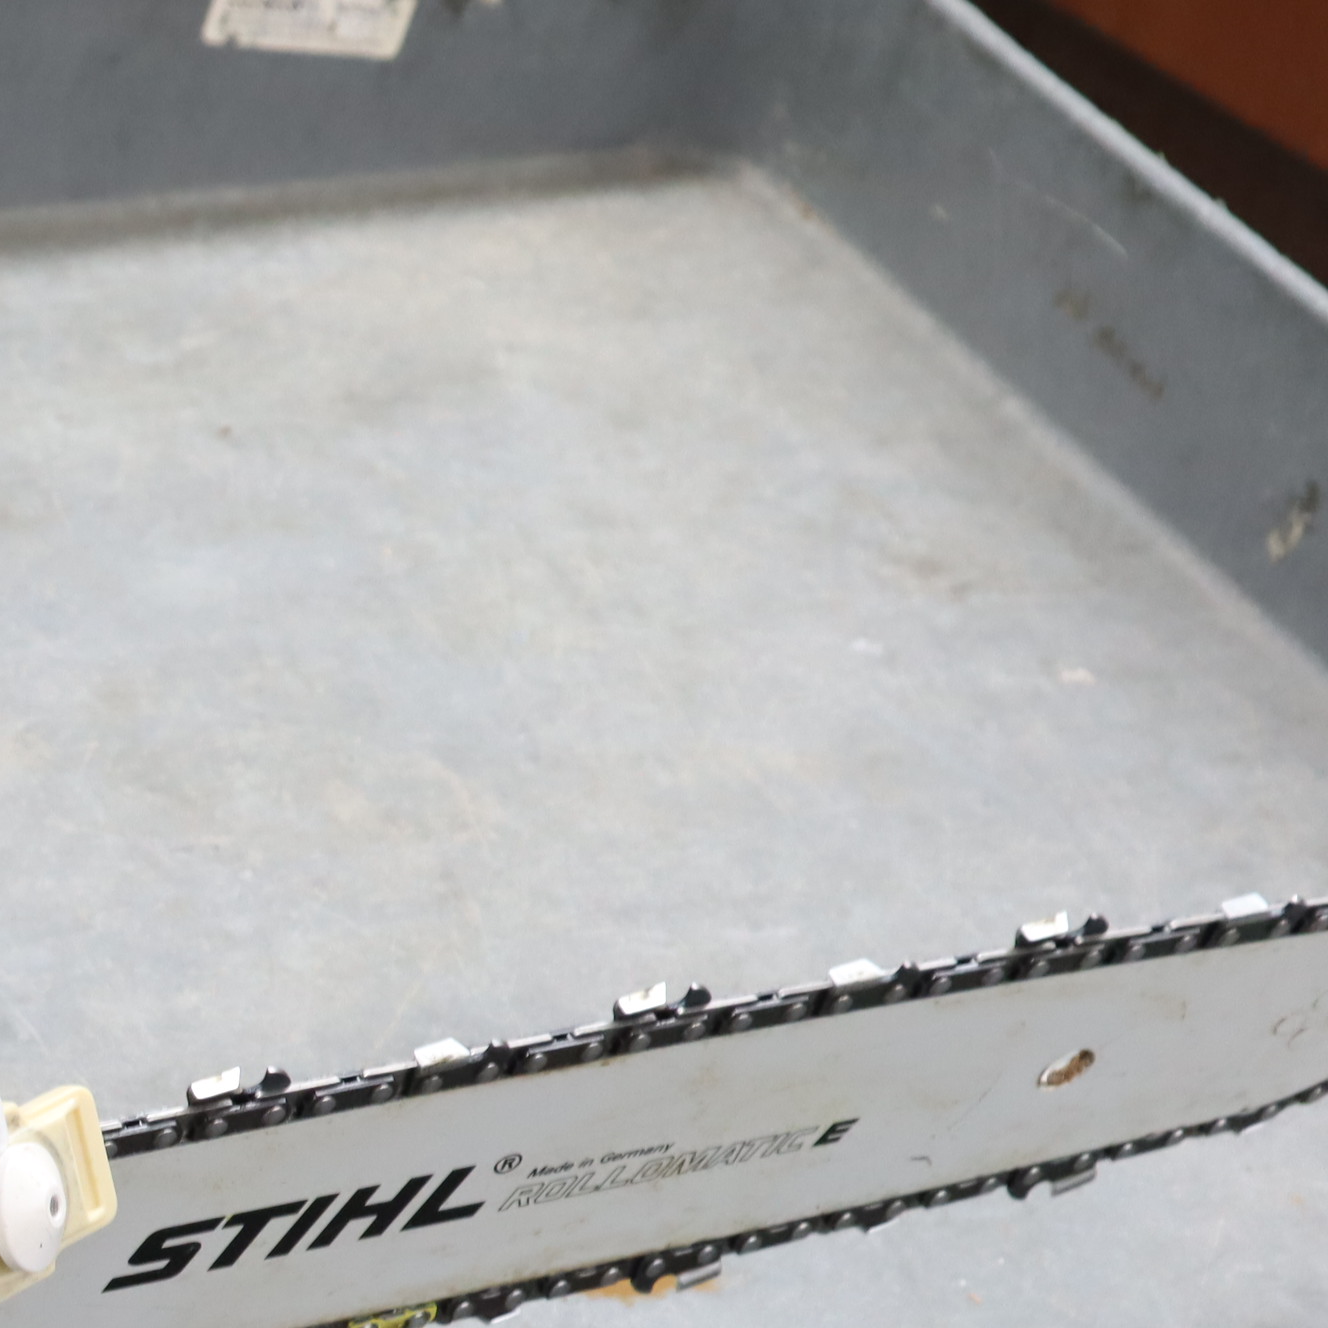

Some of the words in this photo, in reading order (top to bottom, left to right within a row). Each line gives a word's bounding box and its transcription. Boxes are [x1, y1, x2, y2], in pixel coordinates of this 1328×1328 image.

[497, 1126, 819, 1213] ROLLOMATIC
[812, 1117, 860, 1147] E
[526, 1161, 574, 1179] Made
[577, 1157, 595, 1168] in
[599, 1142, 676, 1165] Germany
[102, 1165, 486, 1293] STIHL
